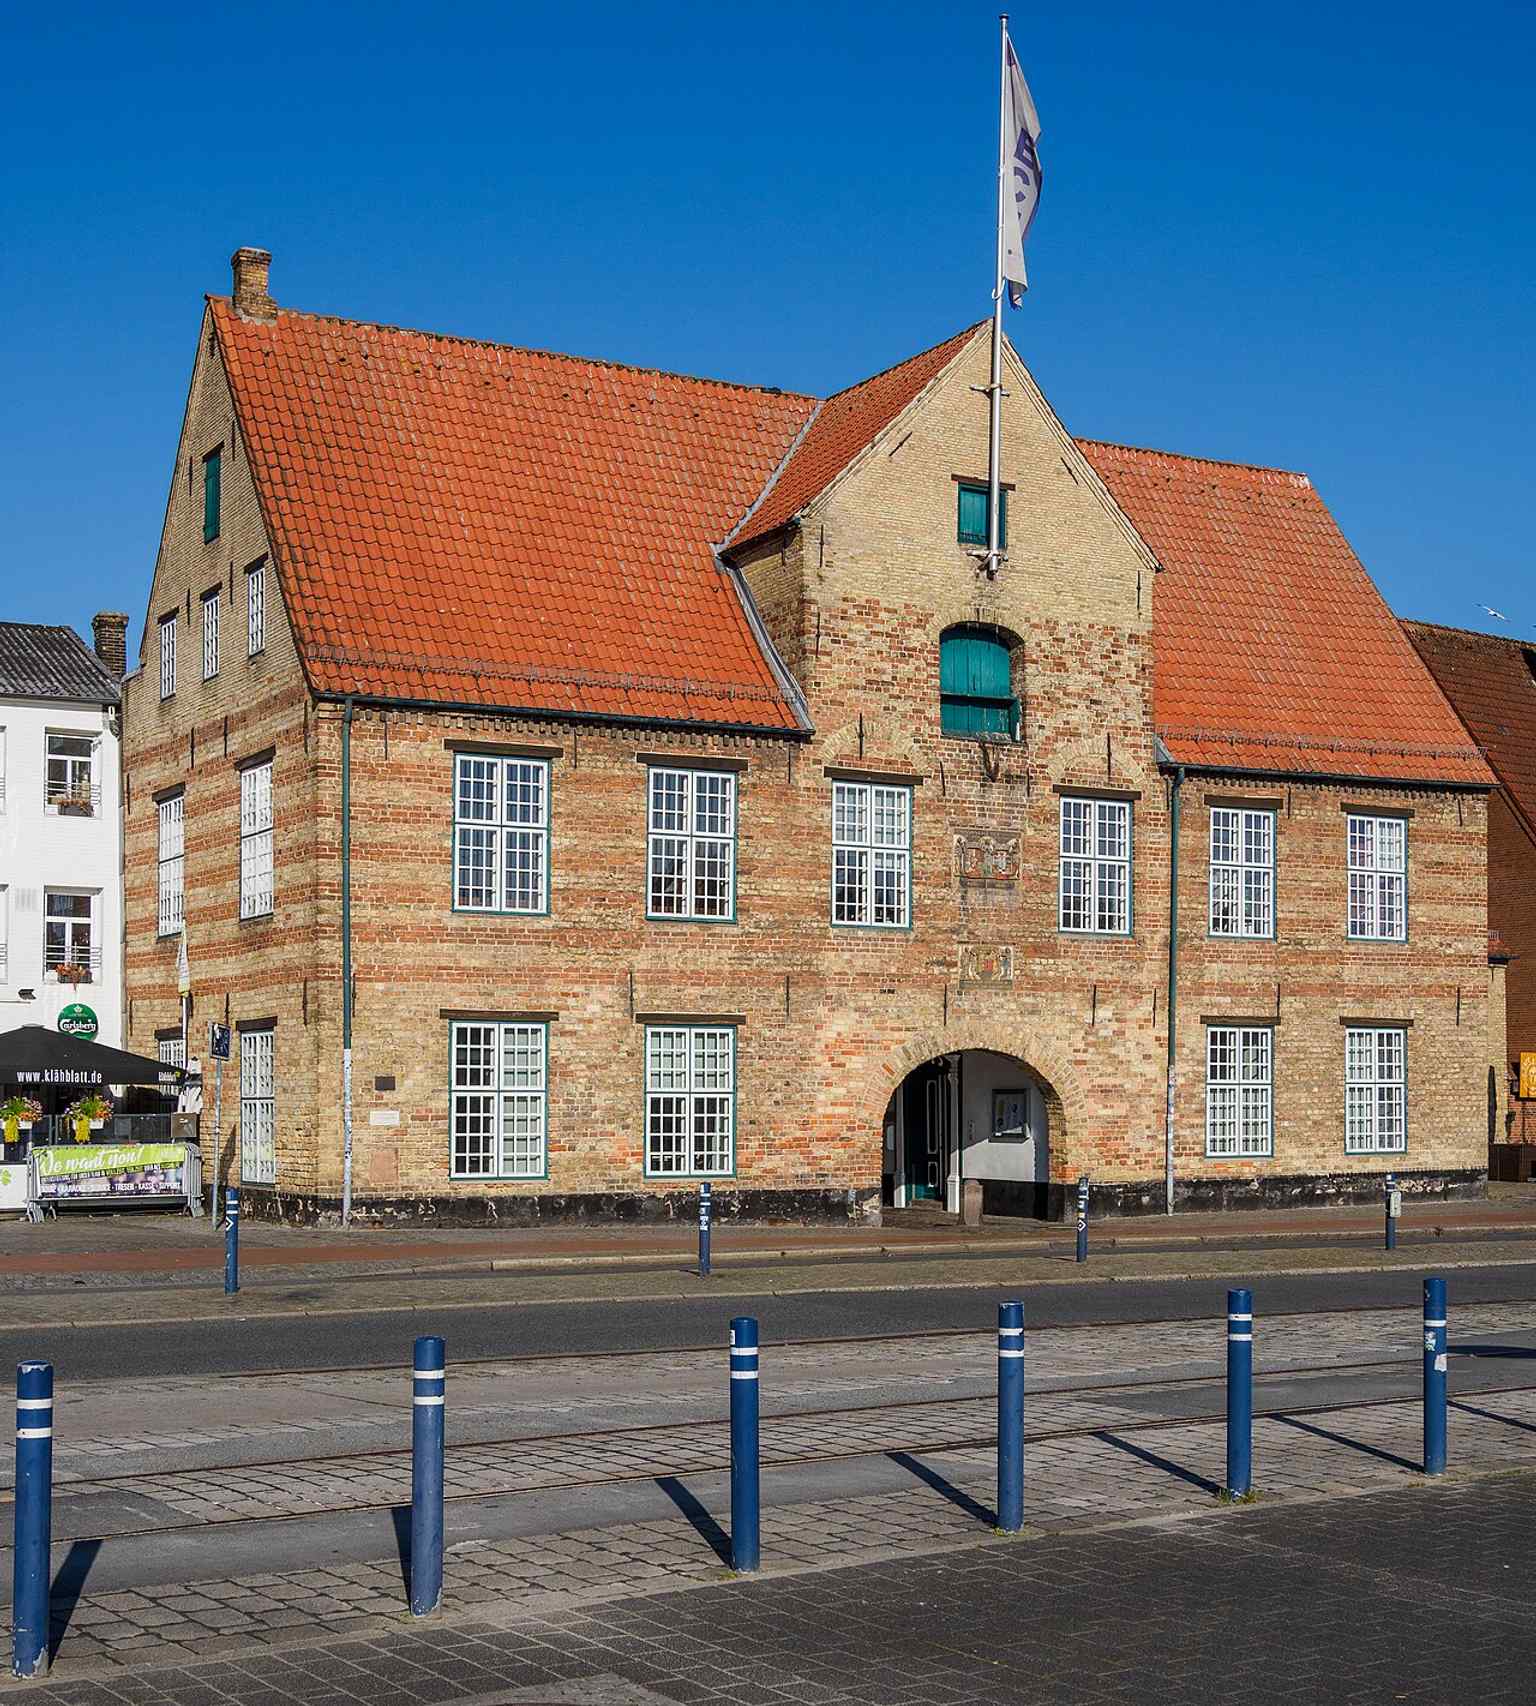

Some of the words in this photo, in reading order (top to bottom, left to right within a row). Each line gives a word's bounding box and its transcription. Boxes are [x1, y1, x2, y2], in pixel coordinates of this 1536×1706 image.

[59, 1018, 96, 1033] Carlsberg
[66, 1150, 108, 1170] want
[109, 1147, 144, 1170] you!
